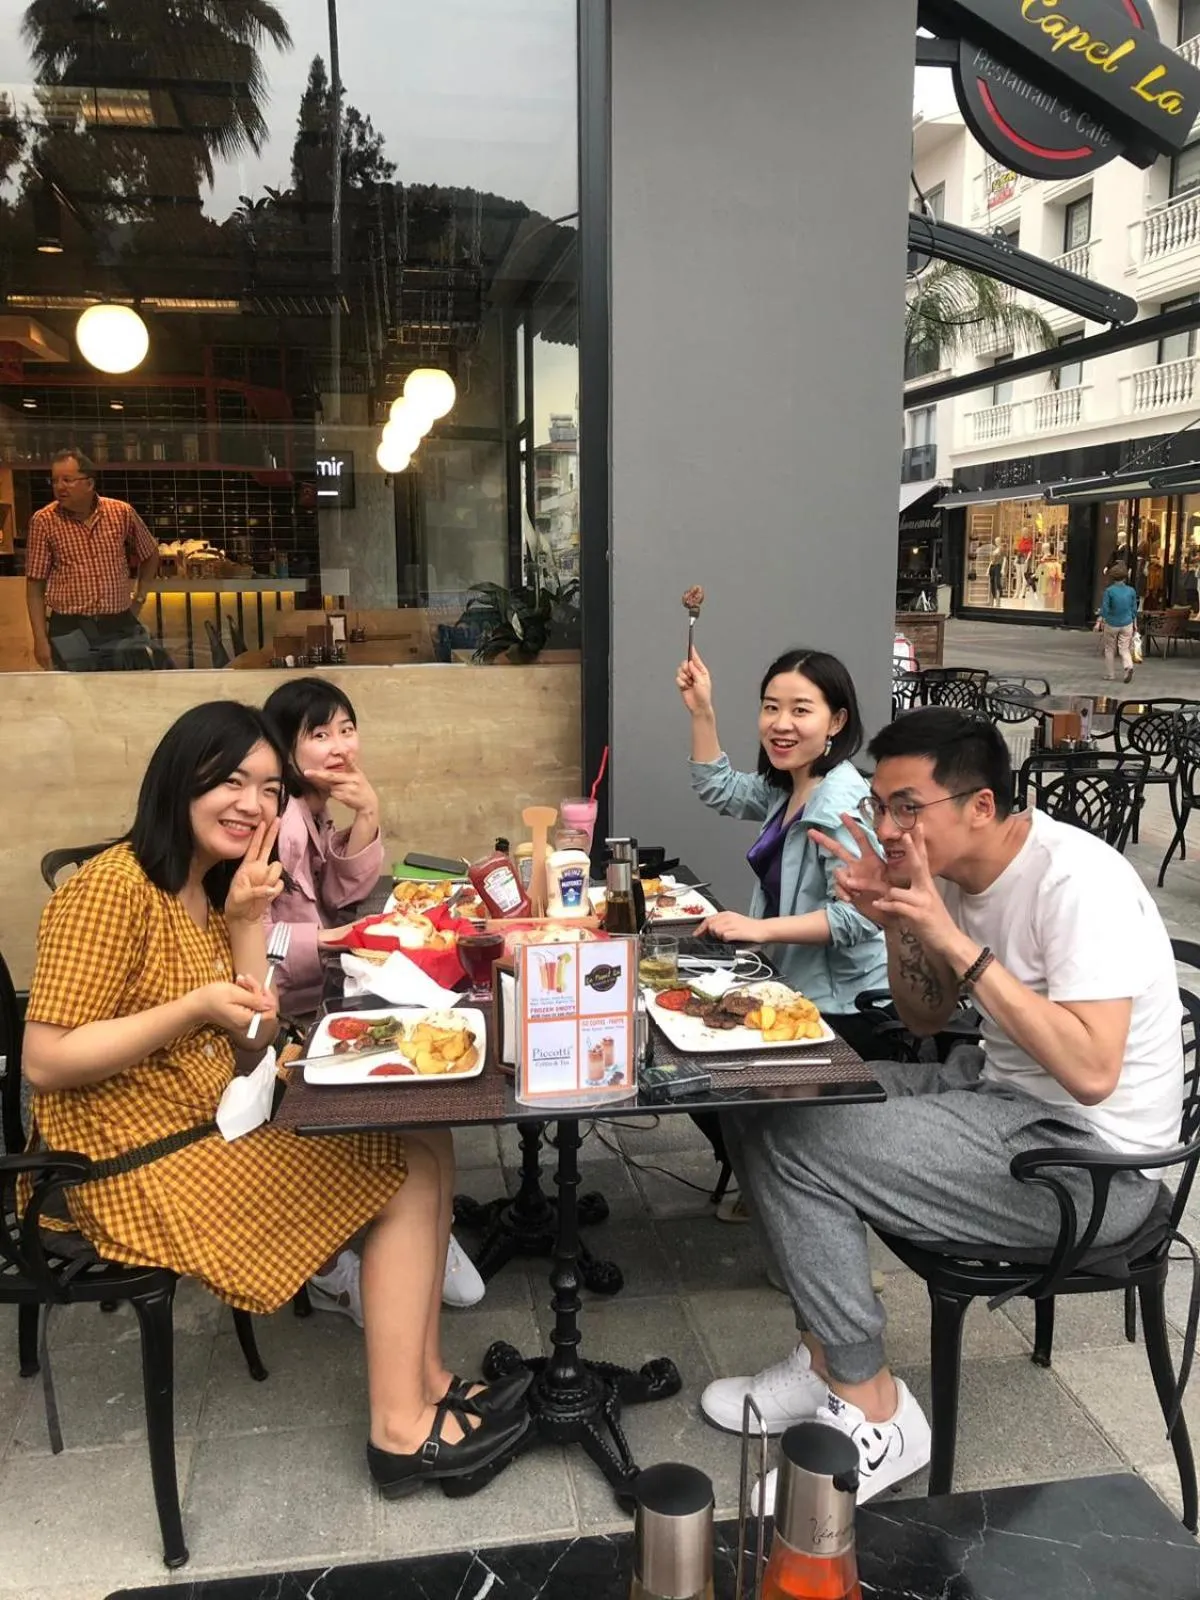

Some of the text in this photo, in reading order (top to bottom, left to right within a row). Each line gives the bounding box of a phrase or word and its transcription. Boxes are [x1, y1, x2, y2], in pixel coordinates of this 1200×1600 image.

[972, 47, 1058, 115] Restaurant
[1059, 107, 1071, 124] &
[1131, 64, 1185, 115] La
[532, 1047, 570, 1059] Piccotti
